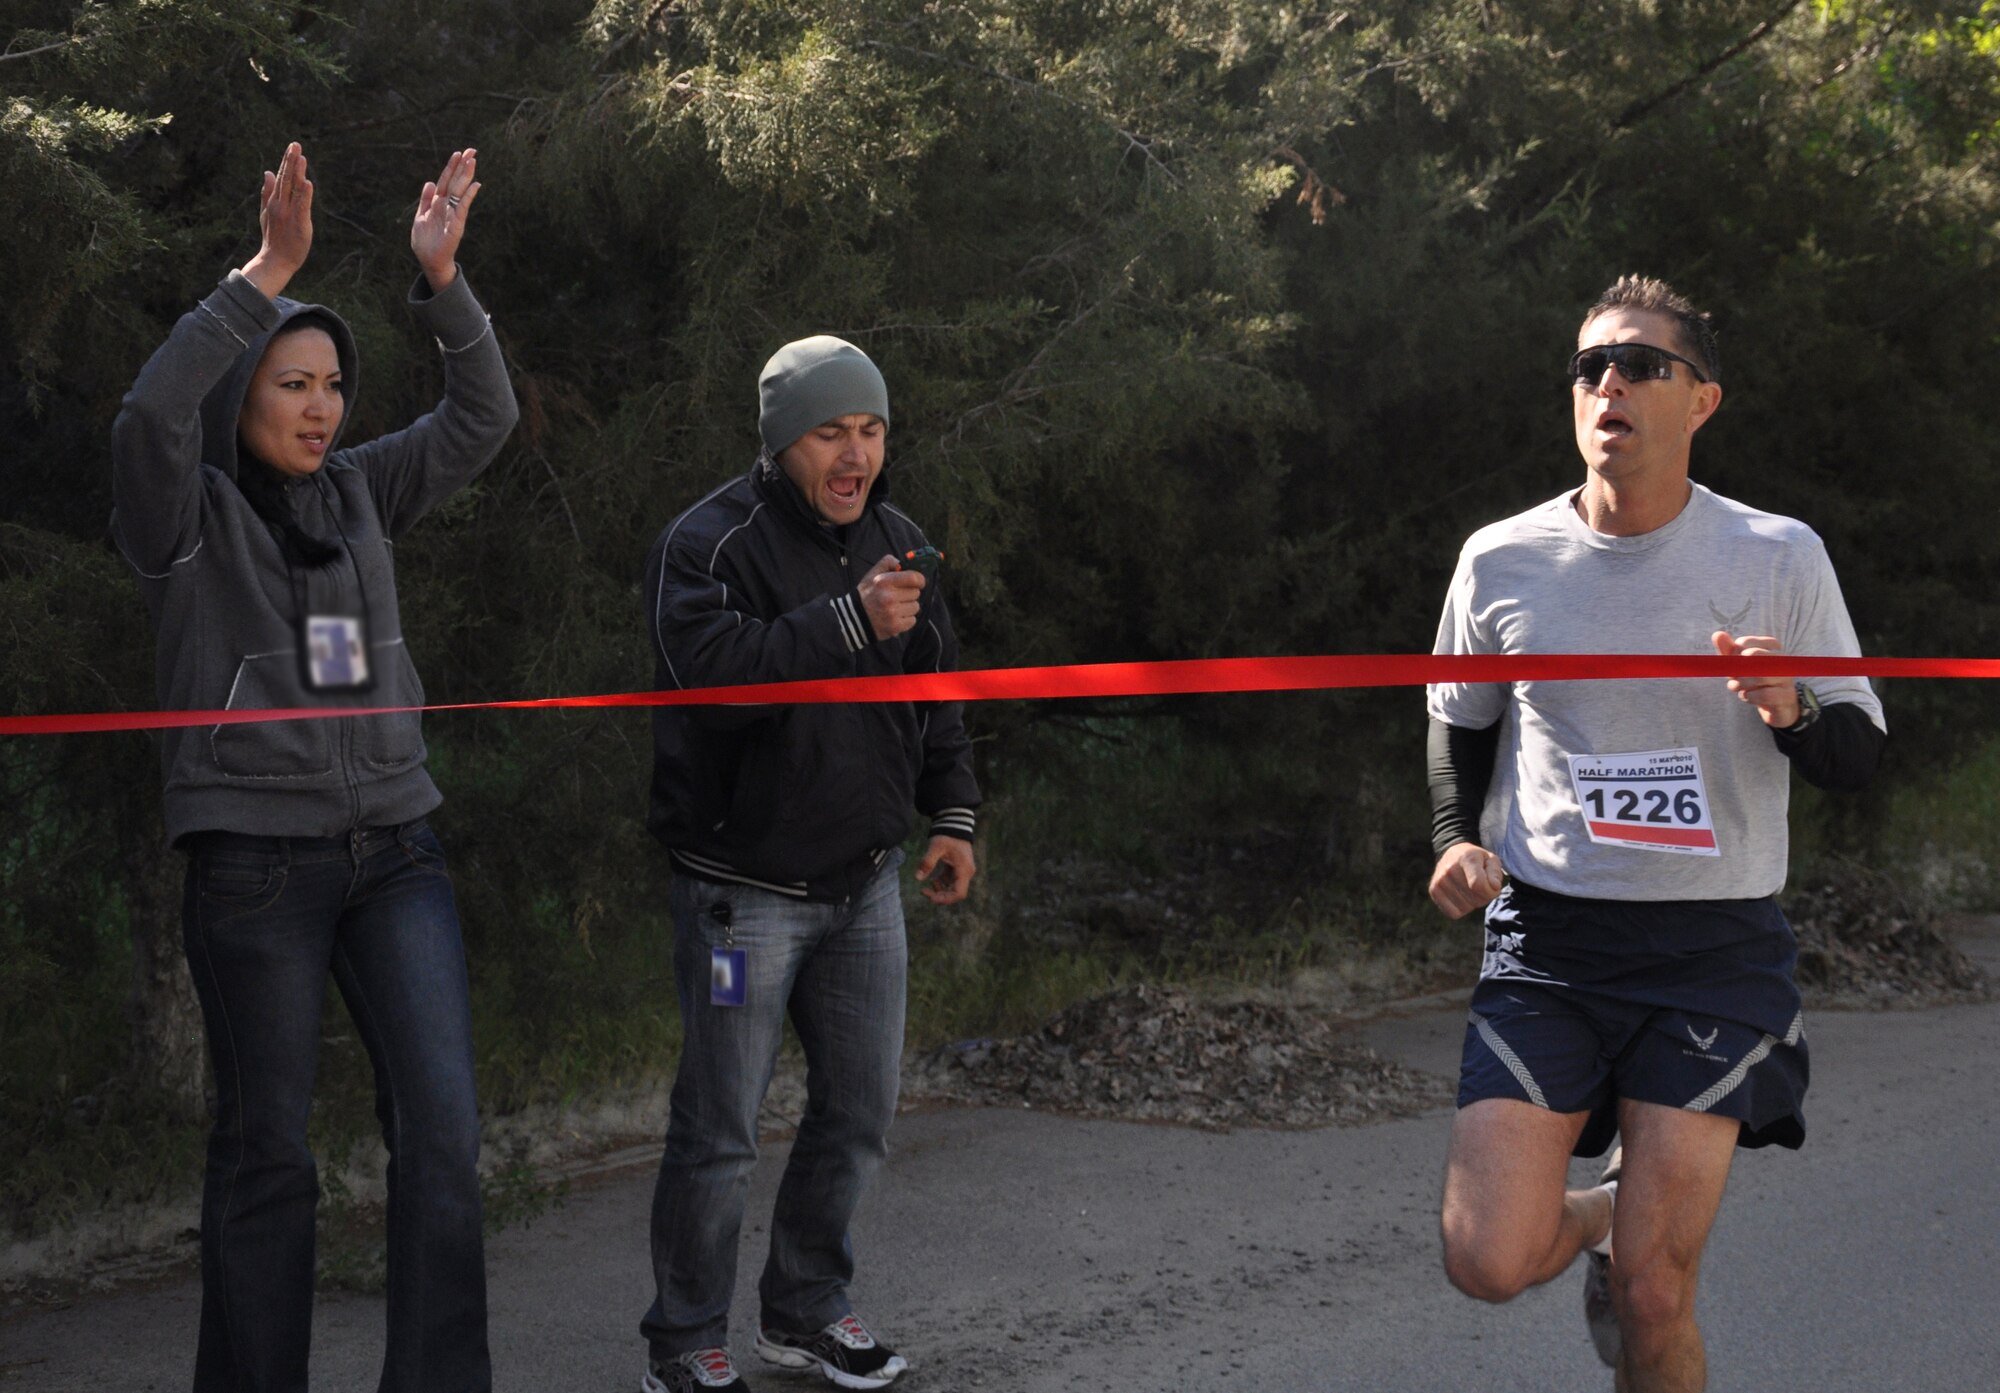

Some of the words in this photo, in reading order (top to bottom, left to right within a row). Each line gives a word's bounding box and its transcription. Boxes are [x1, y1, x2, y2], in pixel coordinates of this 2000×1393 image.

[1578, 768, 1613, 776] HALF
[1617, 764, 1694, 776] MARATHON
[1585, 788, 1702, 825] 1226
